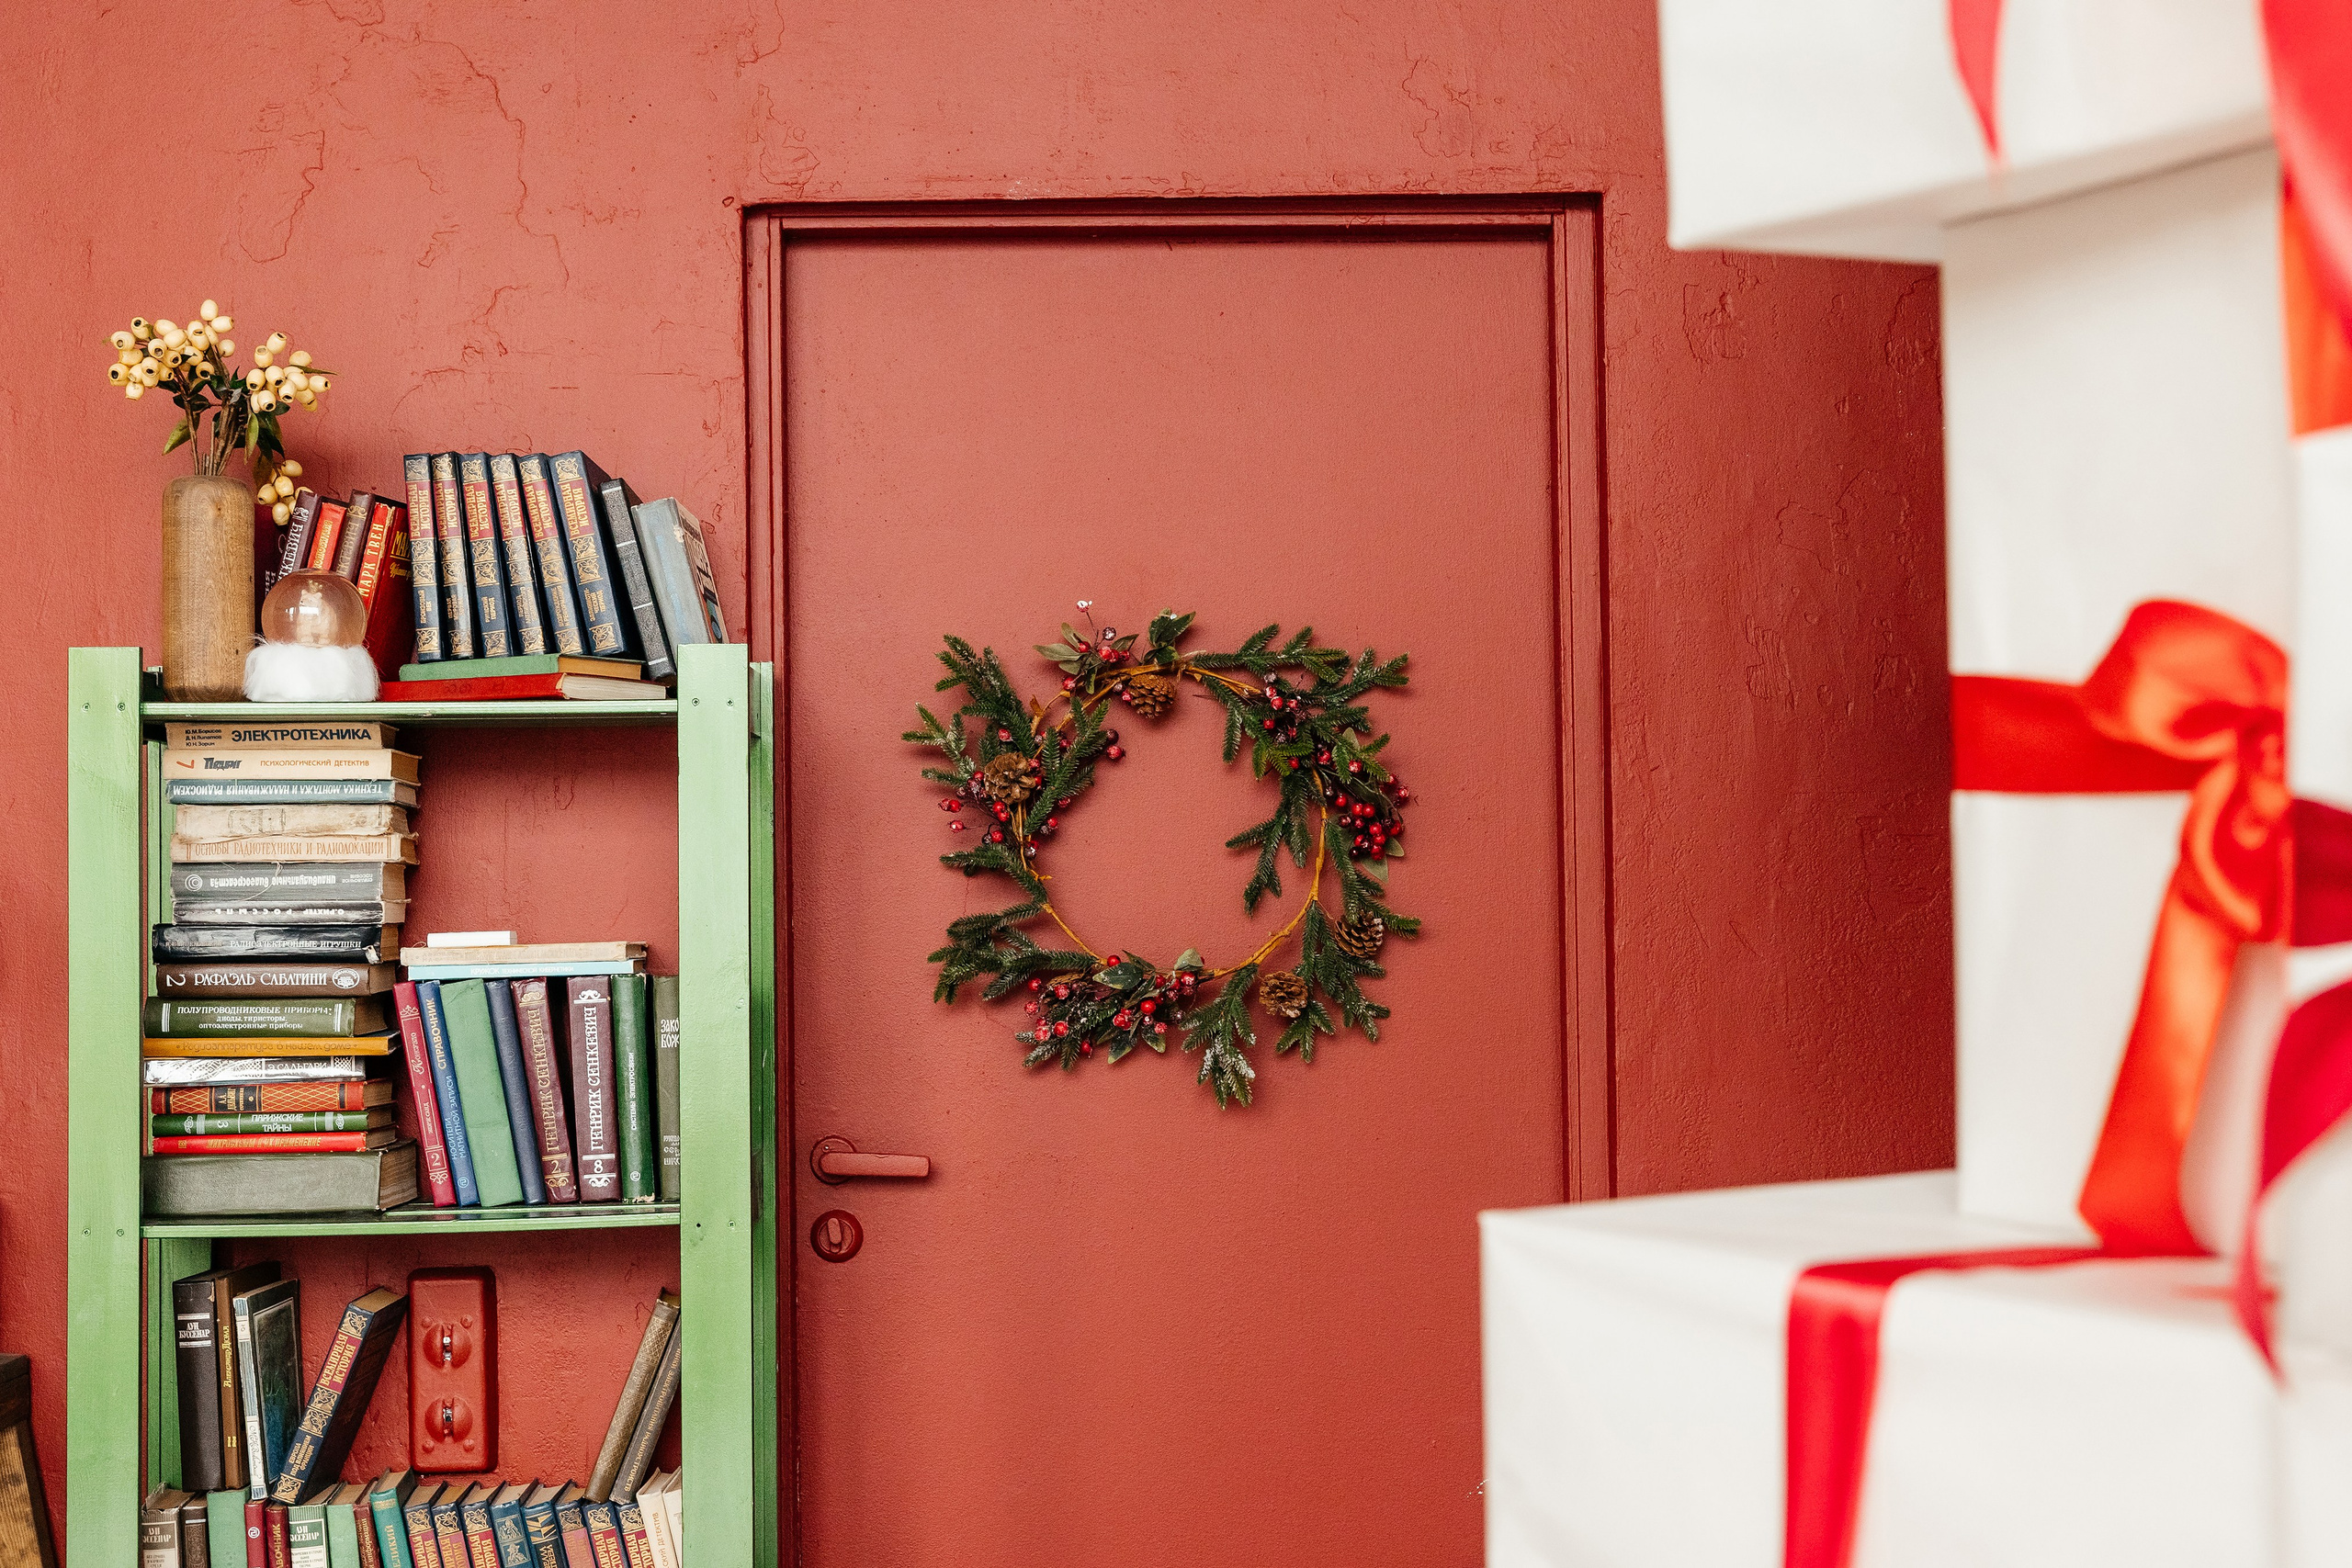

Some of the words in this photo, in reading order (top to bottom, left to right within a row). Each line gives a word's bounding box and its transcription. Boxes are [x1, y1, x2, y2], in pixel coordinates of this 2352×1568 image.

[408, 483, 420, 536] ВСЕМИРНАЯ
[419, 490, 431, 529] ИСТОРИЯ
[434, 483, 447, 536] ВСЕМИРНАЯ
[445, 488, 458, 528] ИСТОРИЯ
[464, 485, 479, 537] ВСЕМИРНАЯ
[476, 491, 490, 530] ИСТОРИЯ
[494, 483, 513, 536] ВСЕМИРНАЯ
[506, 489, 523, 528] ИСТОРИЯ
[524, 485, 543, 537] ВСЕМИРНАЯ
[536, 490, 553, 529] ИСТОРИЯ
[561, 483, 580, 535] ВСЕМИРНАЯ
[572, 487, 590, 526] ИСТОРИЯ
[367, 524, 384, 558] ТВЕН
[359, 562, 376, 597] МАРК
[232, 728, 371, 743] ЭЛЕКТРОТЕХНИКА
[260, 759, 331, 767] ПСИХОЛОГИЧЕСКИЙ
[173, 785, 223, 795] РАДИОСХЕМ
[226, 784, 289, 795] НАЛАЖИВАНИЯ
[292, 784, 298, 794] И
[300, 784, 342, 794] МОНТАЖА
[344, 784, 382, 794] ТЕХНИКА
[195, 843, 229, 855] ОСНОВЫ
[233, 843, 302, 855] РАДИОТЕХНИКИ
[306, 843, 312, 854] И
[316, 841, 384, 855] РАДИОЛОКАЦИИ
[166, 974, 186, 987] 2
[194, 974, 255, 986] РАФАЭЛЬ
[260, 973, 327, 986] САБАТИНИ
[470, 967, 500, 976] КРУЖОК
[177, 1006, 280, 1014] ПОЛУПРОВОДНИКОВЫЕ
[268, 1021, 303, 1031] приборы
[183, 1042, 273, 1053] Радиоаппаратура
[324, 1042, 351, 1052] доме
[425, 998, 447, 1069] СПРАВОЧНИК
[527, 1009, 551, 1088] СЕНКЕВИЧ
[583, 1006, 600, 1085] СЕНКЕВИЧ
[446, 1075, 458, 1105] ЗАПИСИ
[251, 1113, 304, 1123] ПАРИЖСКИЕ
[262, 1123, 292, 1132] ТАЙНЫ
[452, 1106, 466, 1158] МАГНИТНОЙ
[538, 1089, 560, 1152] ГЕНРИК
[589, 1088, 604, 1150] ГЕНРИК
[445, 1118, 457, 1159] НОСИТЕЛИ
[432, 1153, 441, 1167] 2
[551, 1160, 561, 1173] 2
[594, 1160, 603, 1173] 8
[179, 1329, 210, 1339] БУССЕНАР
[187, 1322, 199, 1331] ЛУИ
[320, 1334, 348, 1386] ВСЕМИРНАЯ
[333, 1345, 356, 1383] ИСТОРИЯ
[288, 1443, 301, 1464] ЕВРОПА
[290, 1463, 301, 1476] ПОД
[297, 1435, 311, 1464] ВЛИЯНИЕМ
[296, 1526, 308, 1534] ЛУИ
[653, 1512, 664, 1547] ДЕТЕКТИВ
[660, 1548, 670, 1568] СКИЙ
